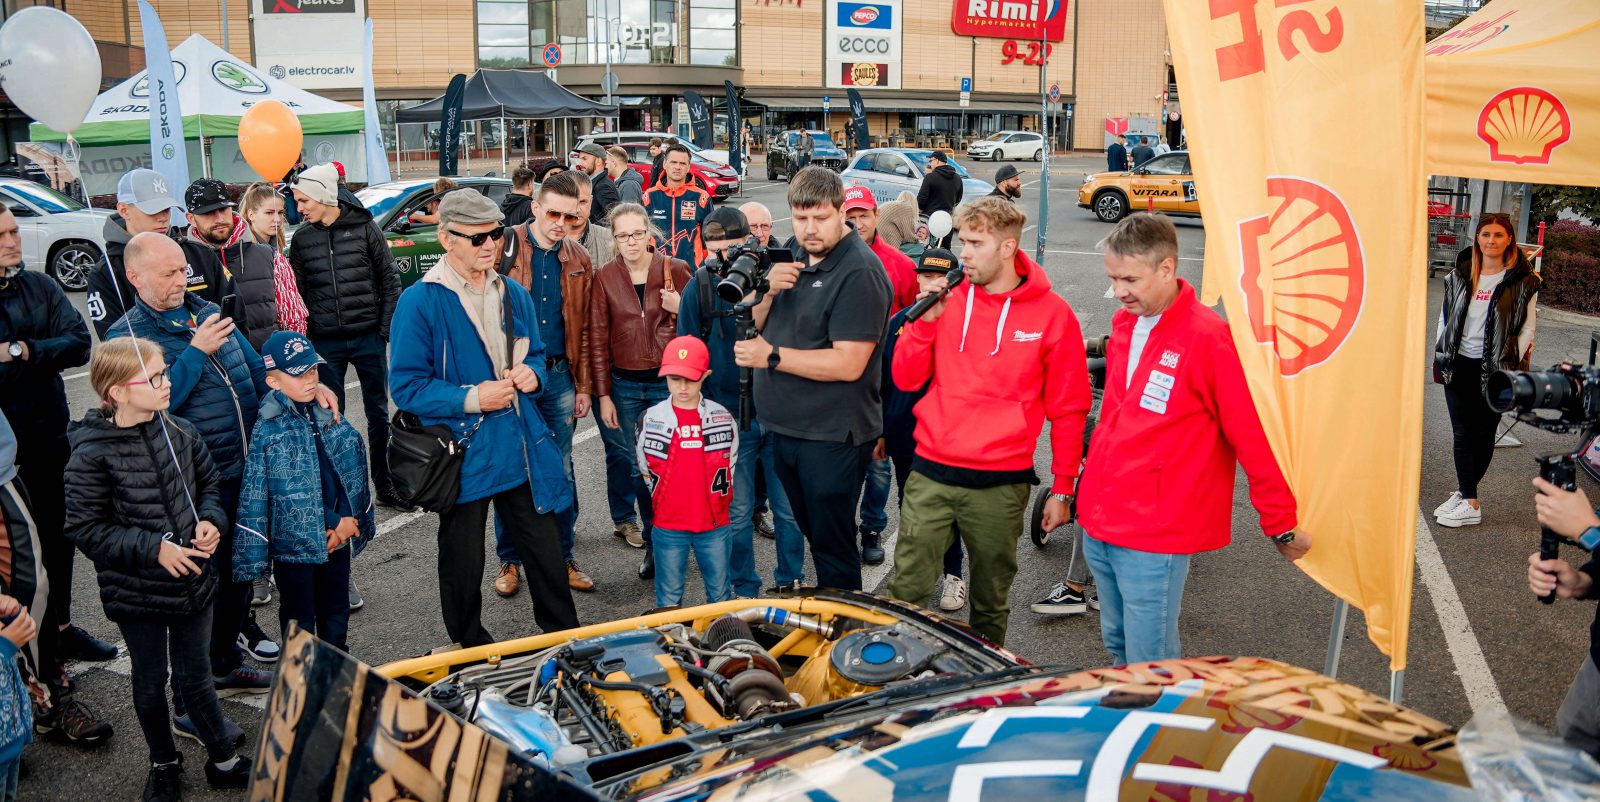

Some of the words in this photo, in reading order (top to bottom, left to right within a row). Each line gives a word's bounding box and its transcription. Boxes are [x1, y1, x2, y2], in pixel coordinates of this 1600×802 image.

[854, 12, 875, 20] PEPCO
[968, 0, 1039, 21] Rimi
[966, 18, 1037, 28] Hypermarket
[839, 37, 889, 54] ecco
[1001, 40, 1053, 65] 9-22
[289, 66, 355, 76] electrocar.lv
[854, 67, 876, 82] SAULES
[446, 107, 454, 170] AUTOBRAVA
[709, 432, 732, 443] RIDE
[711, 467, 730, 496] 4
